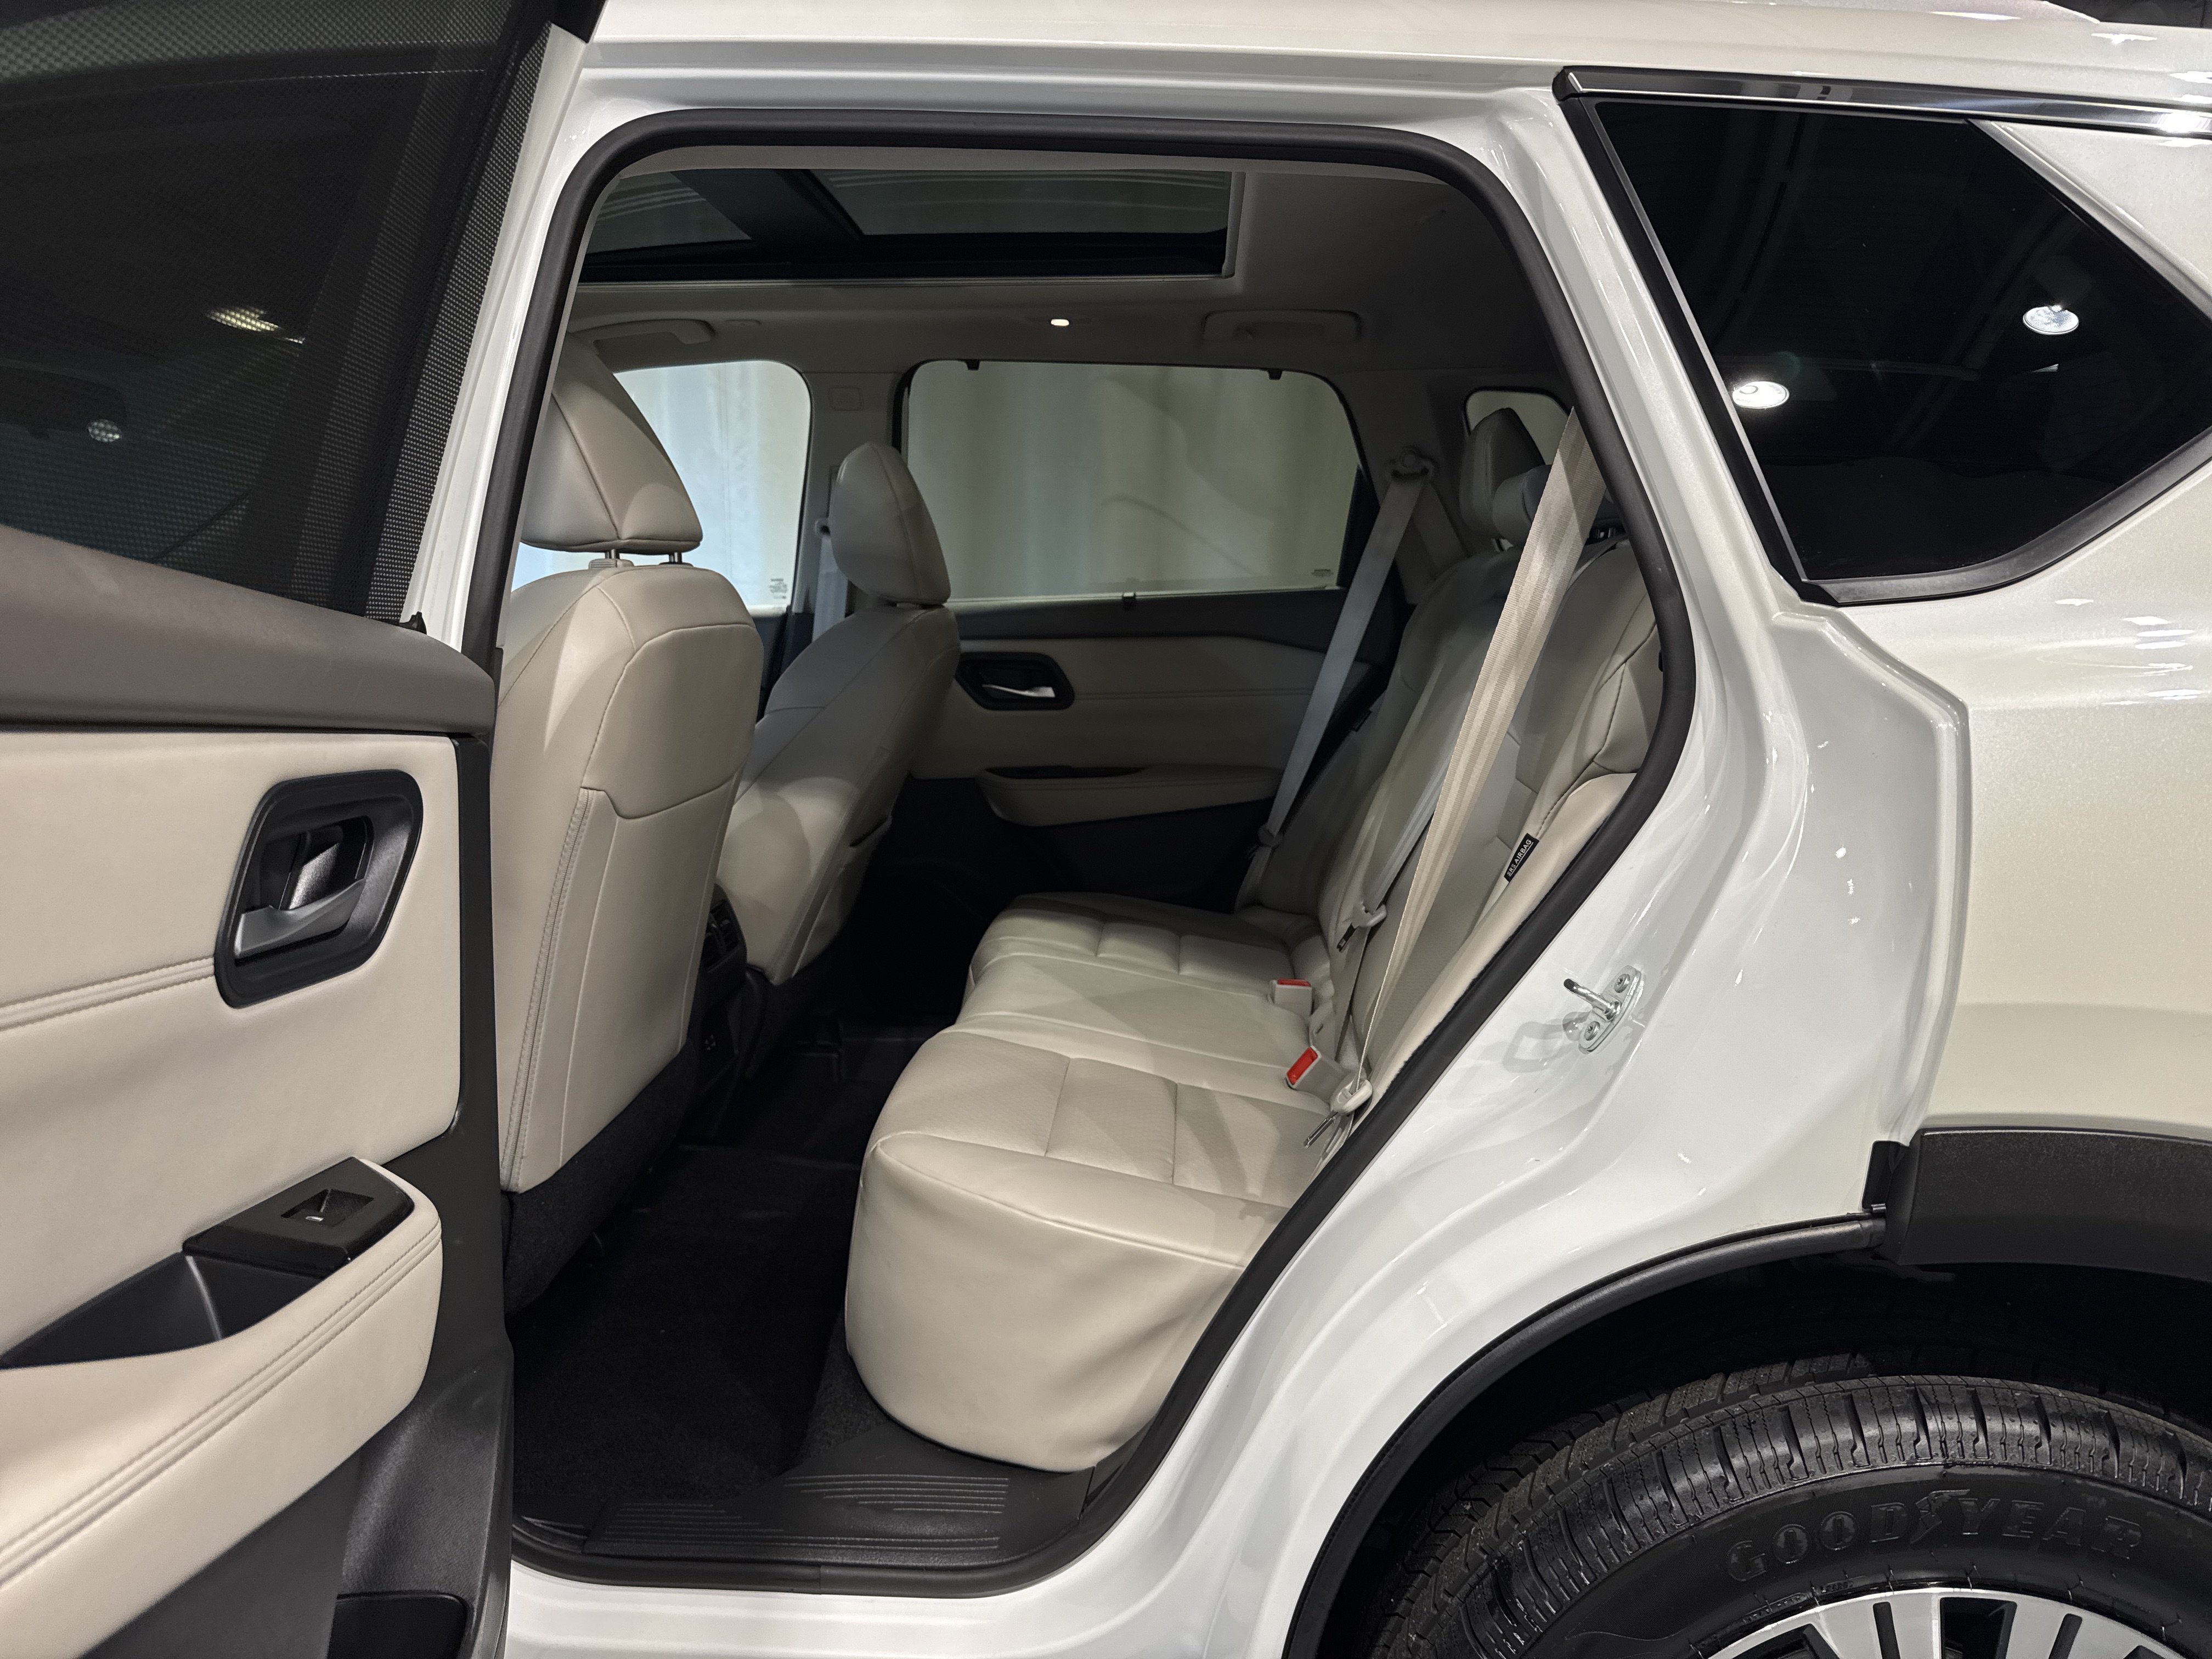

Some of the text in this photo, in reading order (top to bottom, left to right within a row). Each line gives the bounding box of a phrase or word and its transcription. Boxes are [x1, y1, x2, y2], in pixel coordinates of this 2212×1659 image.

[1506, 839, 1532, 877] SRS AIRBAG
[1726, 1493, 2144, 1582] GOODYEAR
